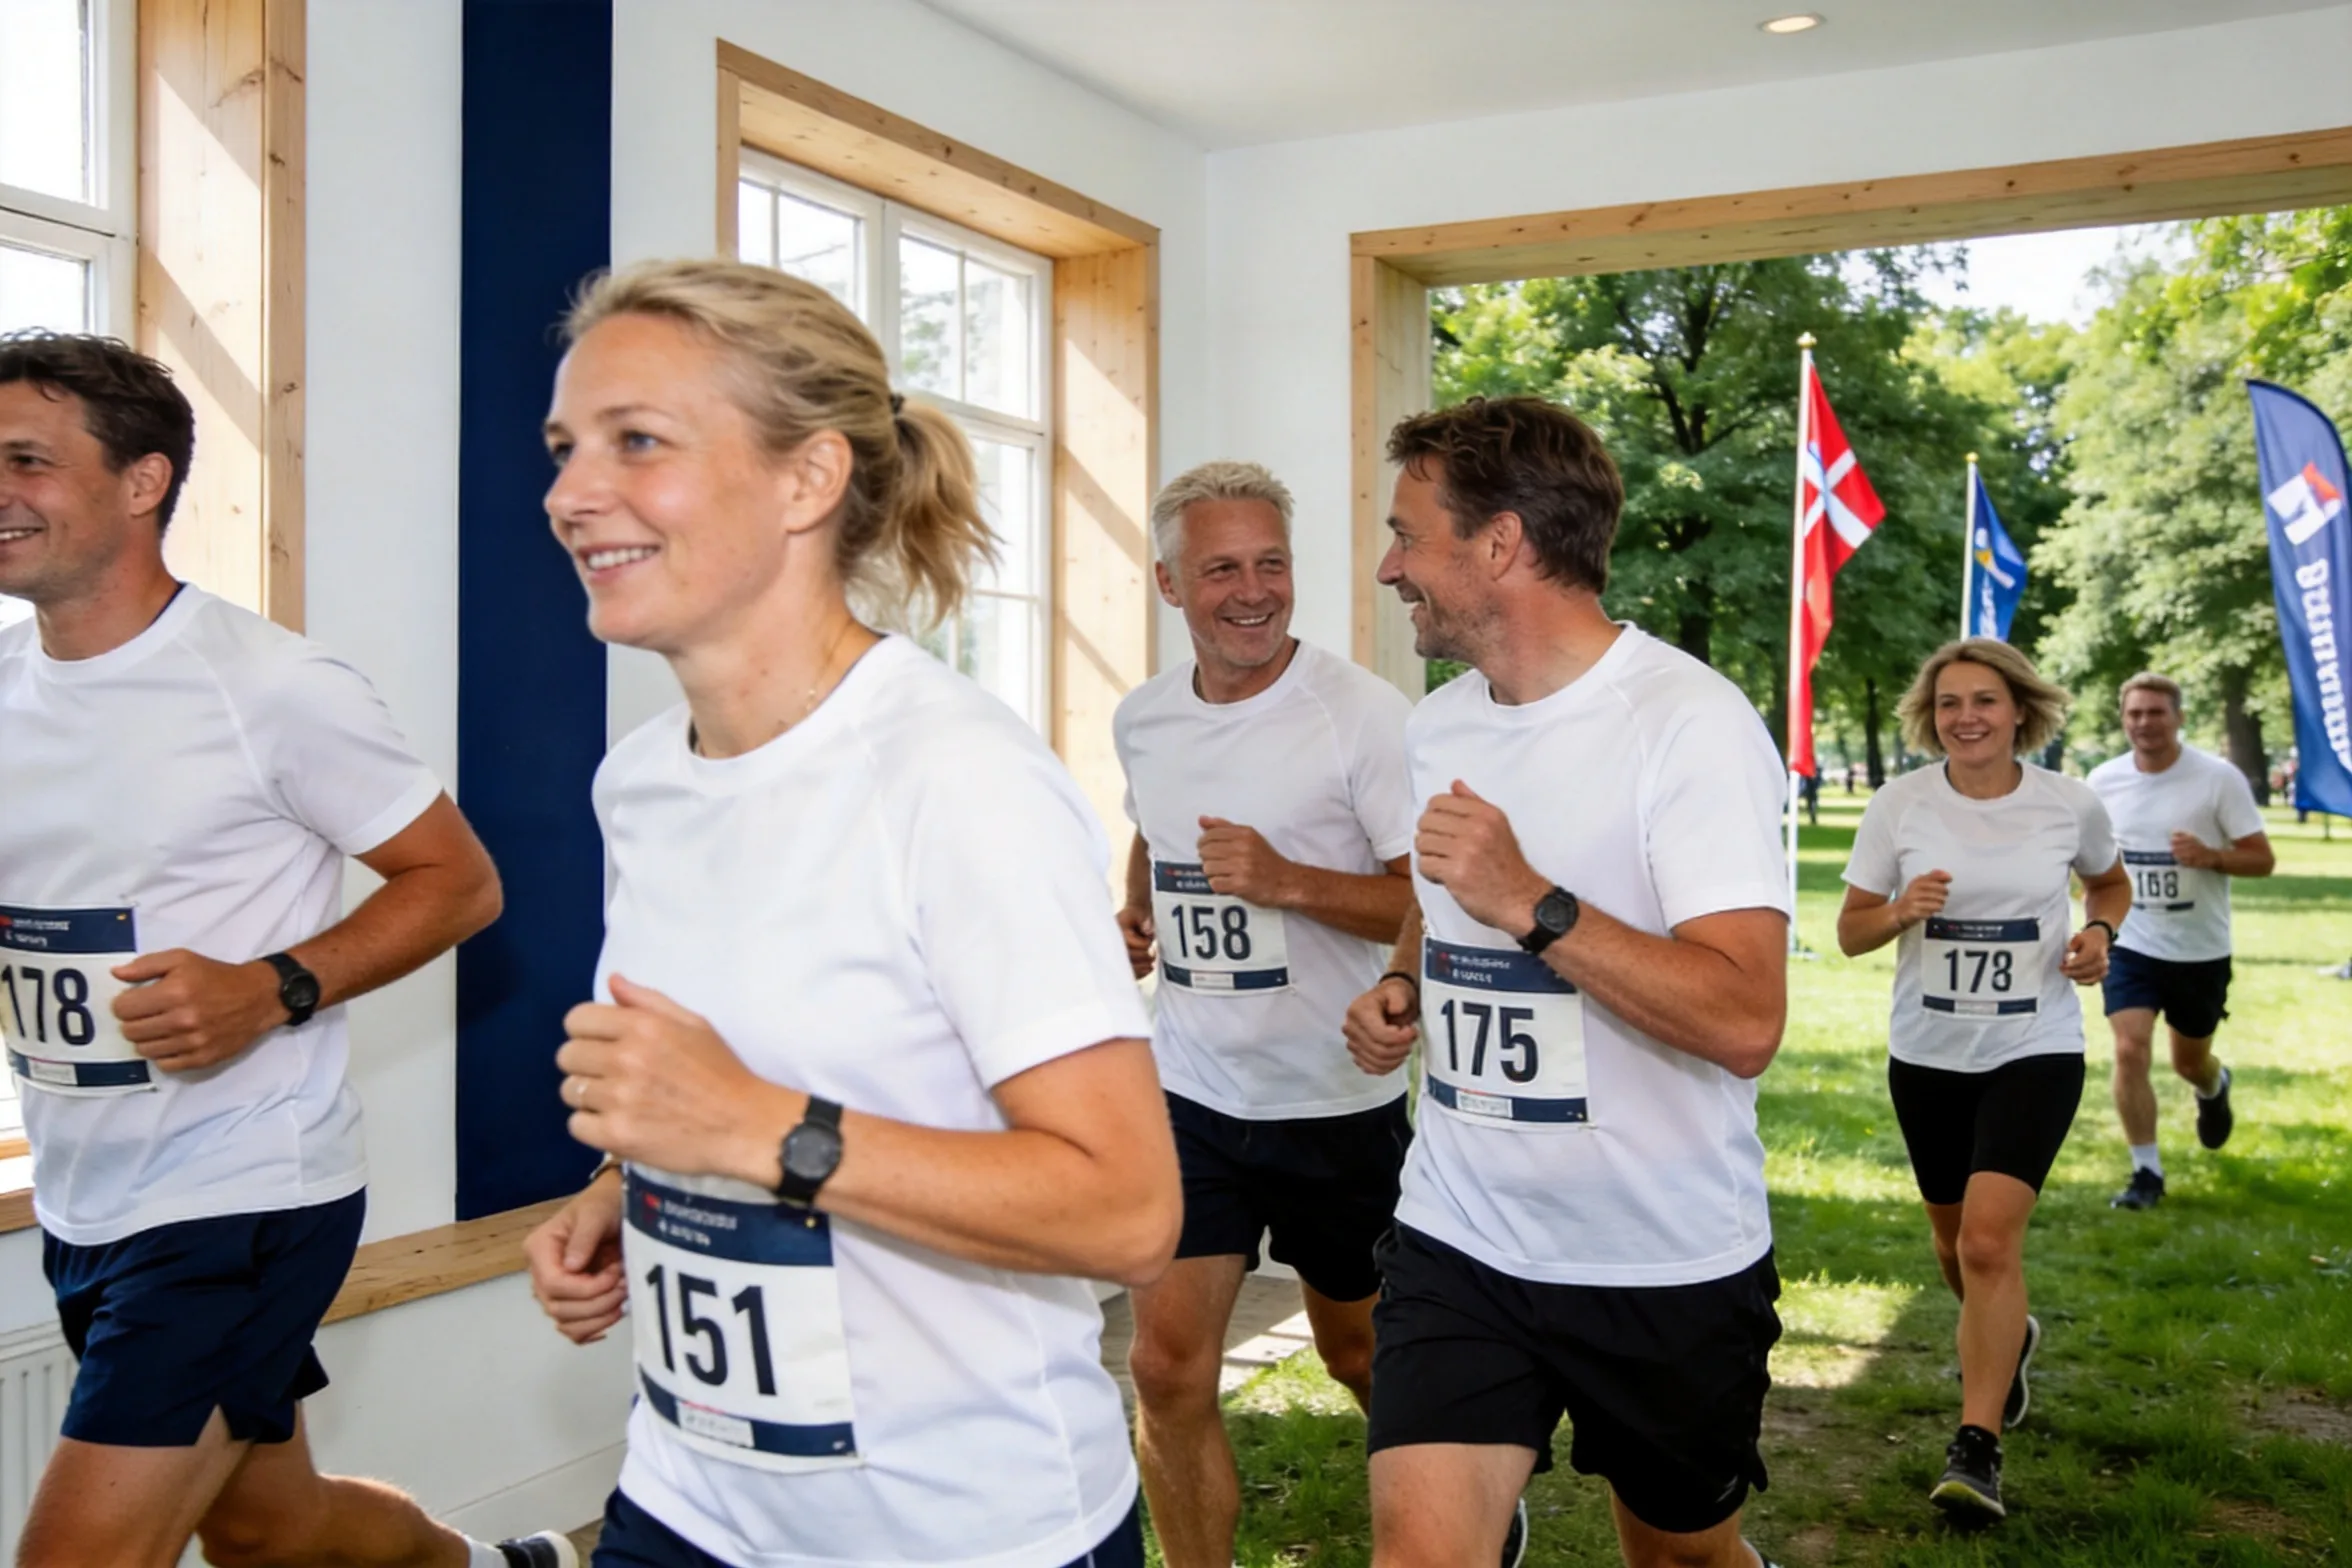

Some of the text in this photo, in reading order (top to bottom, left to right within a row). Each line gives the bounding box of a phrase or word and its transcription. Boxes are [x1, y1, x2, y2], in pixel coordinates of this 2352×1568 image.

[1172, 904, 1252, 960] 158
[1, 964, 95, 1046] 178
[1441, 999, 1539, 1083] 175
[645, 1264, 778, 1397] 151
